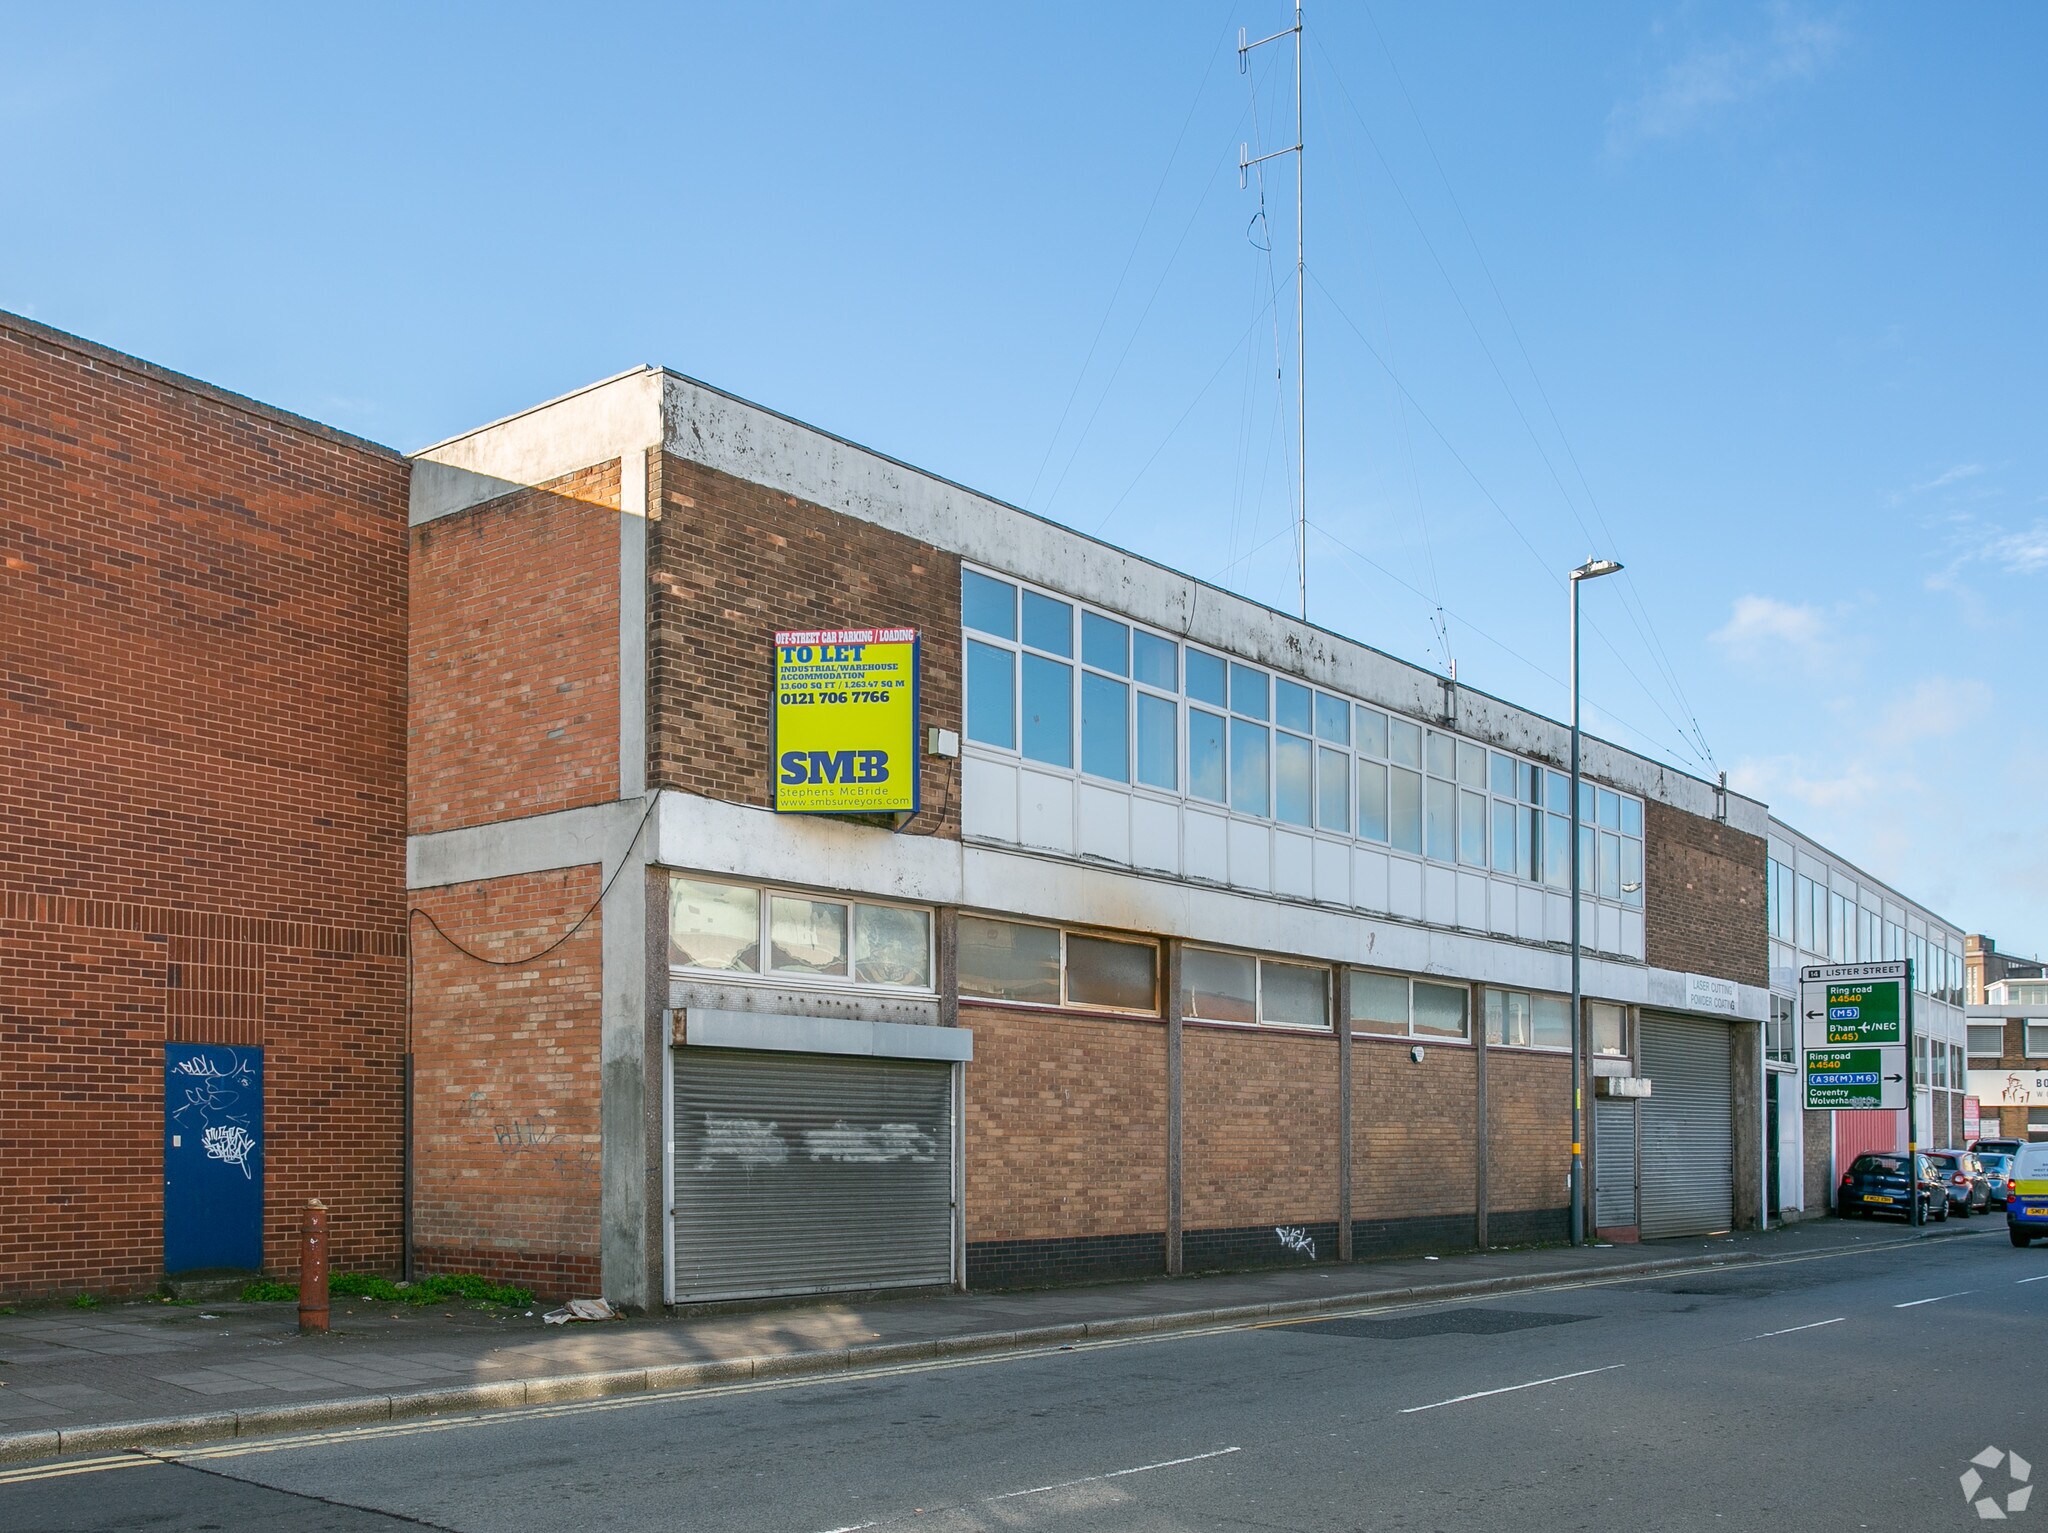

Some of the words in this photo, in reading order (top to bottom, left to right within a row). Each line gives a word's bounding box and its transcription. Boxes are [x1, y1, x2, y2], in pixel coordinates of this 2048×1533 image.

[775, 631, 820, 645] OFF-STREET
[821, 631, 839, 644] CAR
[839, 630, 873, 643] PARKING
[873, 629, 879, 644] /
[879, 629, 914, 642] LOADING
[780, 645, 813, 663] TO
[820, 645, 866, 662] LET
[780, 664, 898, 673] INDUSTRIAL/WAREHOUSE
[780, 672, 865, 681] ACCOMMODATION
[780, 682, 808, 690] 13,600
[810, 682, 823, 690] SQ
[824, 681, 836, 689] FT
[844, 681, 878, 690] 1,263.47
[880, 680, 893, 688] SQ
[780, 693, 815, 705] 0121
[819, 692, 848, 704] 706
[851, 691, 890, 704] 7766
[780, 750, 890, 785] SMB
[780, 788, 834, 798] Stephens
[840, 787, 888, 796] McBride
[780, 797, 909, 808] www.smbsurveyors.com
[1826, 968, 1860, 977] LISTER
[1862, 966, 1901, 975] STREET
[1693, 980, 1710, 991] LASER
[1711, 982, 1733, 995] CUTTING
[1830, 986, 1850, 995] Ring
[1852, 985, 1873, 993] road
[1691, 993, 1712, 1006] POWDER
[1830, 994, 1862, 1003] A4540
[1829, 1024, 1856, 1032] B'ham
[1809, 1052, 1829, 1061] Ring
[1831, 1052, 1851, 1060] road
[1809, 1061, 1841, 1069] A4540
[1809, 1088, 1849, 1097] Coventry
